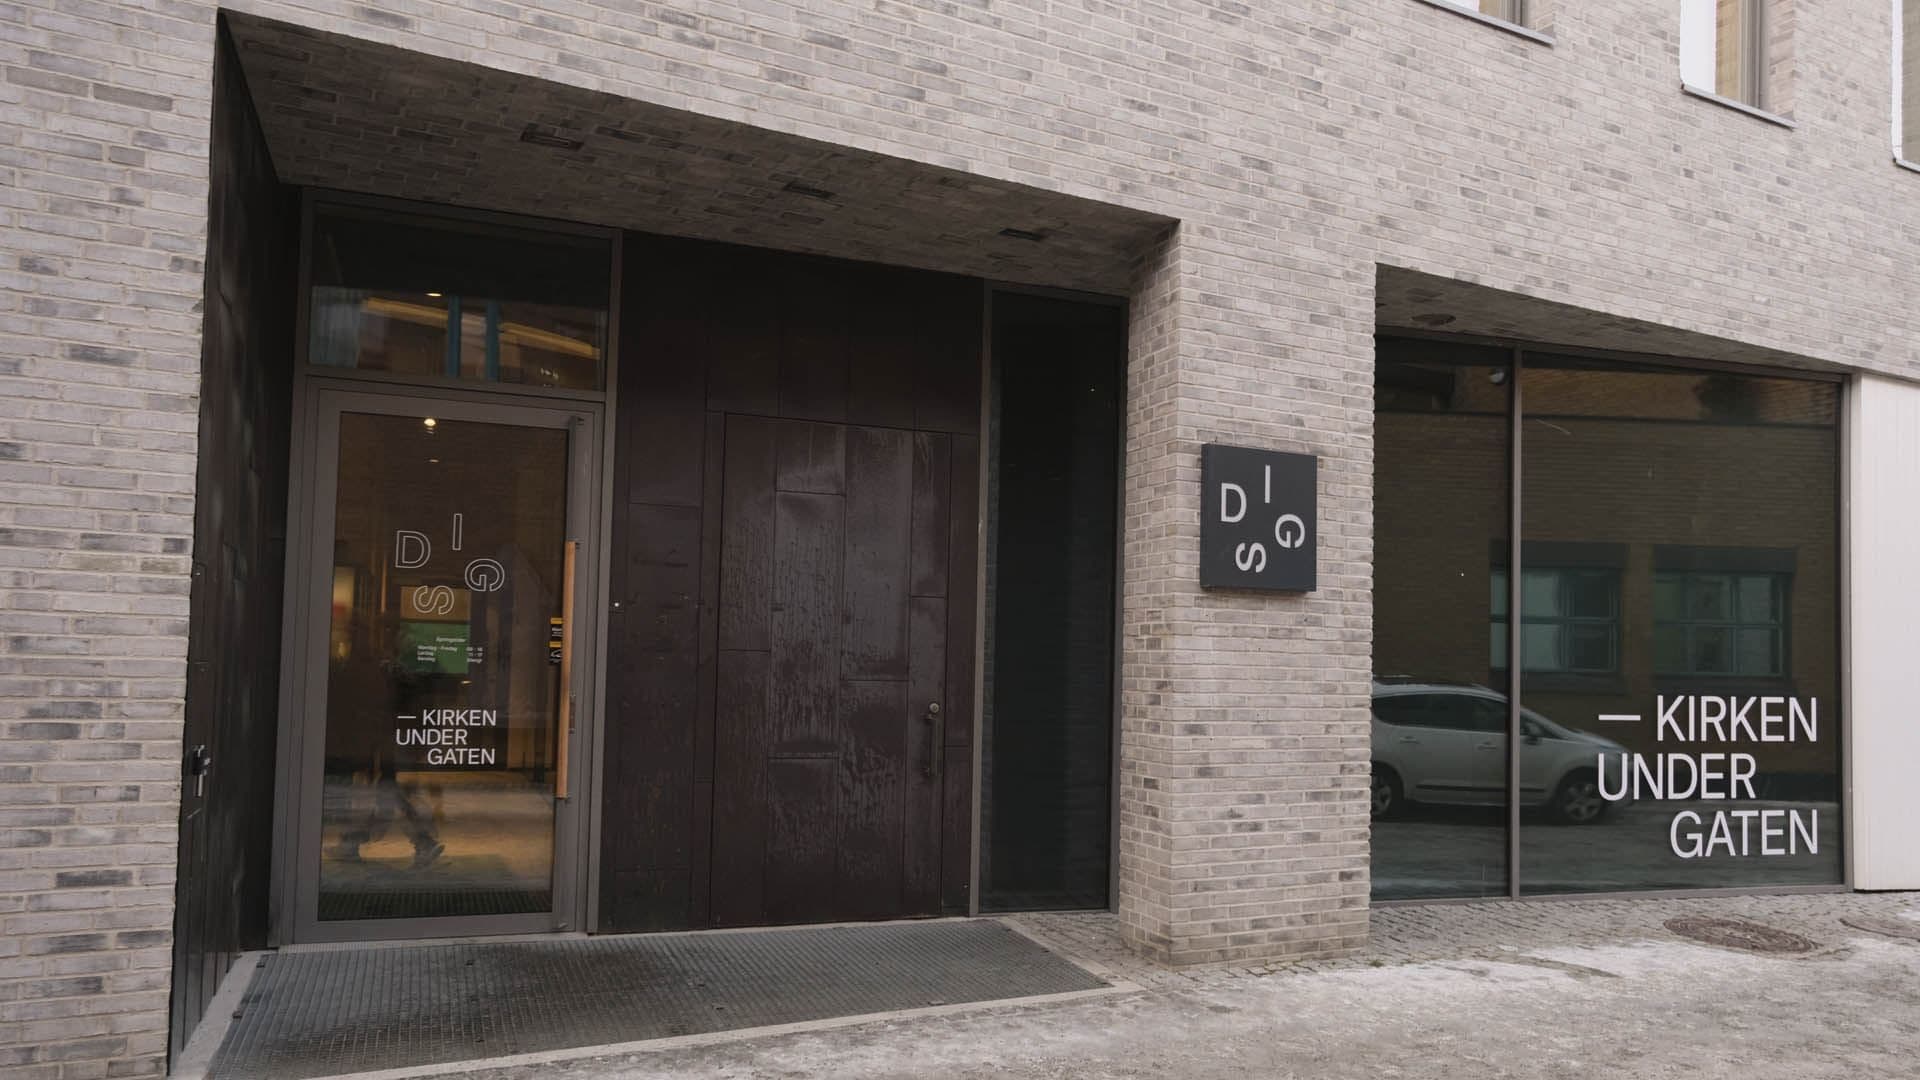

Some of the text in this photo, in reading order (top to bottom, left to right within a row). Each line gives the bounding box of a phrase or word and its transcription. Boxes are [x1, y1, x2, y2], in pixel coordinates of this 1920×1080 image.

[422, 709, 497, 726] KIRKEN
[1657, 694, 1817, 742] KIRKEN
[396, 728, 468, 745] UNDER
[427, 747, 495, 765] GATEN
[1597, 752, 1757, 801] UNDER
[1670, 808, 1819, 858] GATEN
